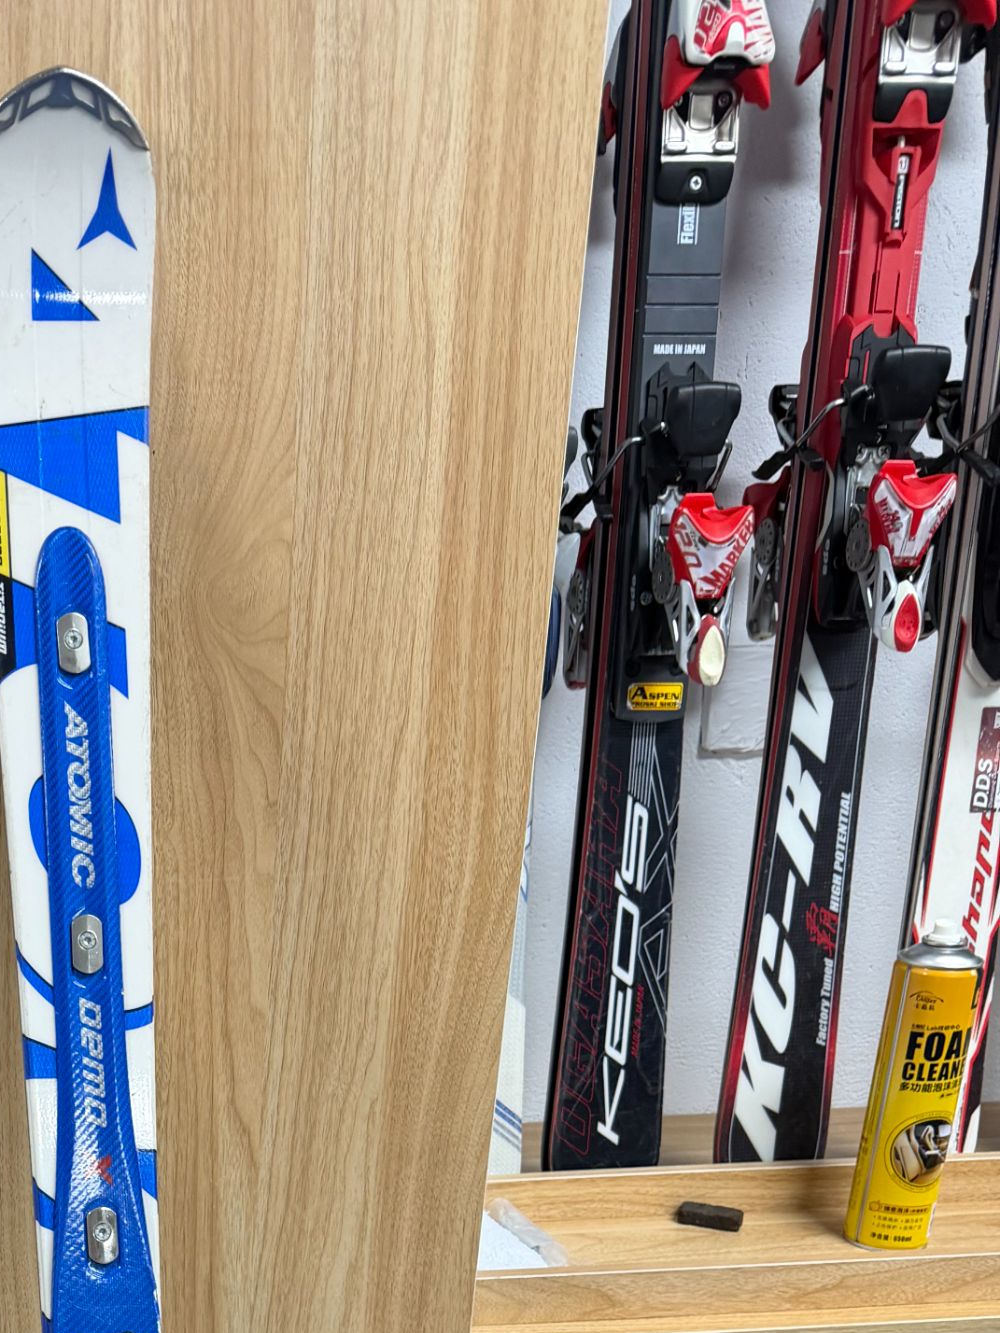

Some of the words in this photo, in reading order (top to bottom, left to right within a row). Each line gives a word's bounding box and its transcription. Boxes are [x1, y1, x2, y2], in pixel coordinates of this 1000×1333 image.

[653, 344, 673, 355] MADE
[674, 343, 682, 355] IN
[683, 343, 706, 355] JAPAN
[711, 518, 754, 588] MARKER
[64, 700, 96, 889] ATOMIC
[833, 792, 852, 872] POTENTIAL
[830, 873, 844, 913] HIGH
[597, 794, 650, 1146] KEO'S
[820, 958, 835, 998] Tuned
[815, 999, 831, 1046] Factory
